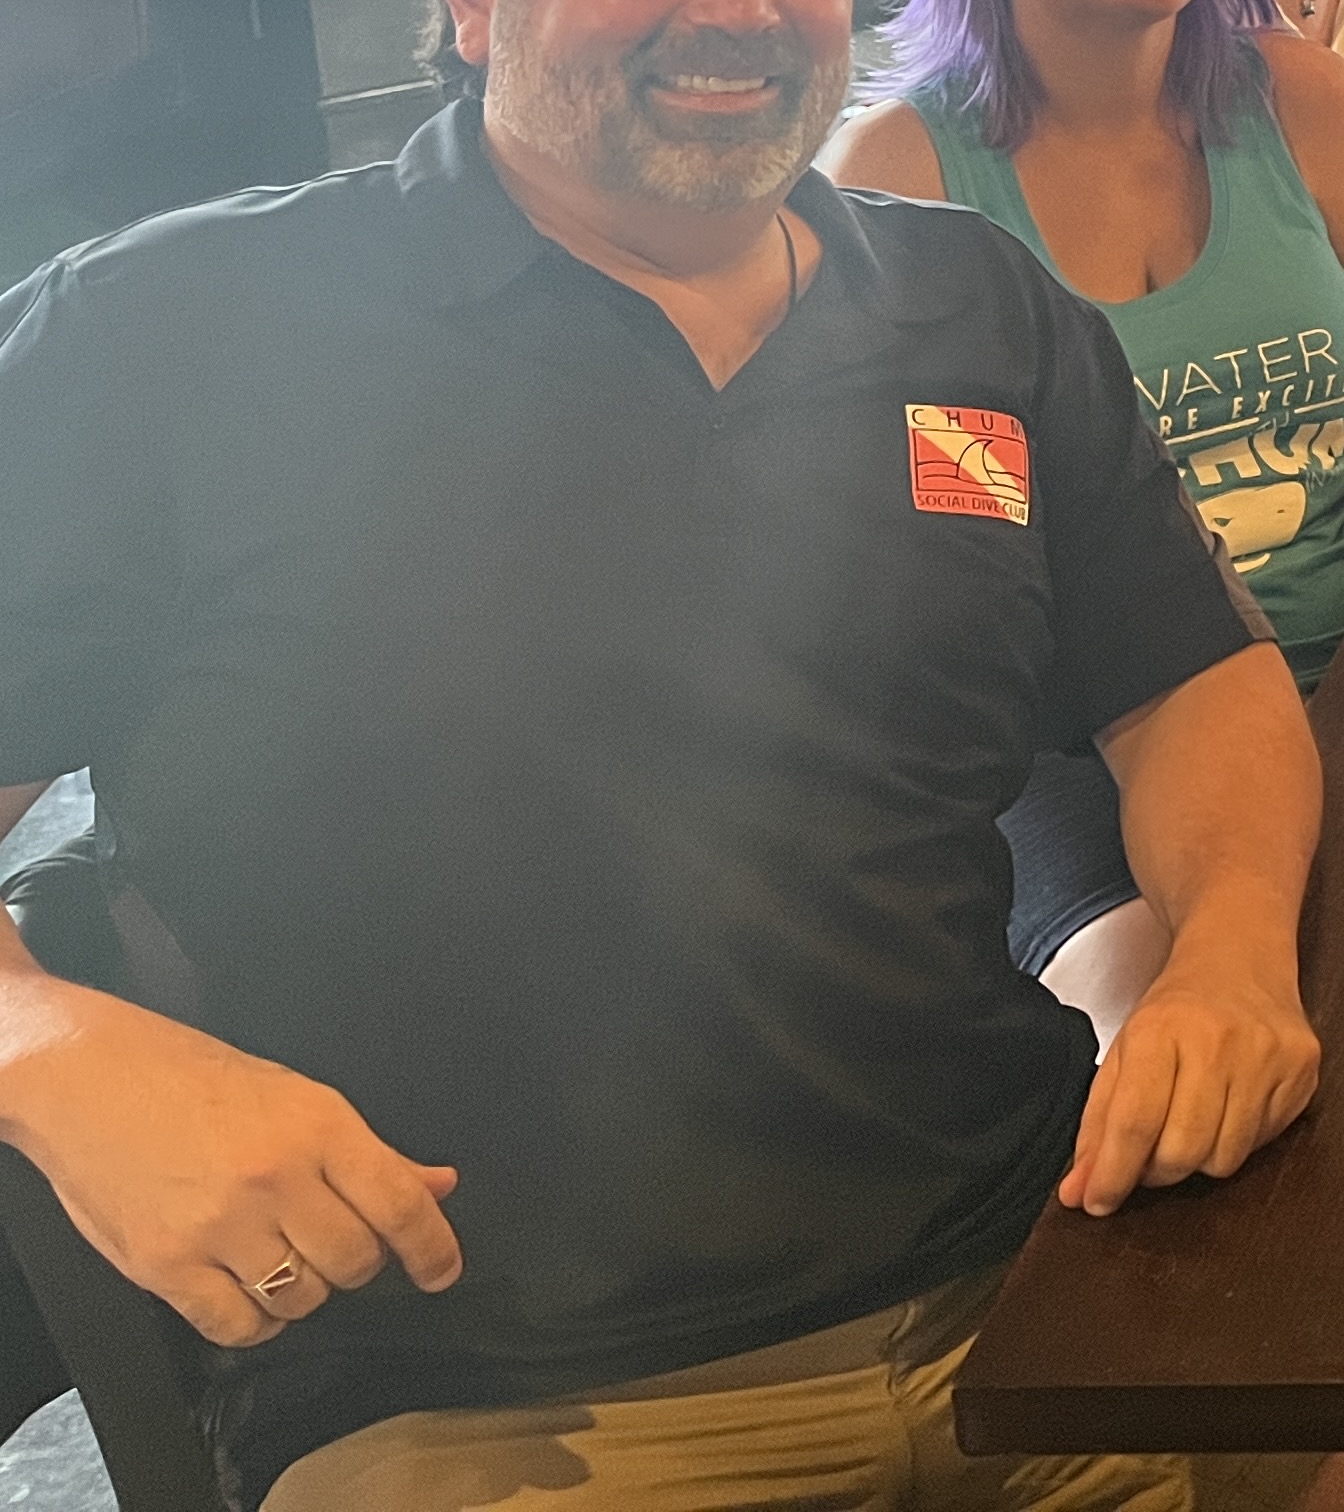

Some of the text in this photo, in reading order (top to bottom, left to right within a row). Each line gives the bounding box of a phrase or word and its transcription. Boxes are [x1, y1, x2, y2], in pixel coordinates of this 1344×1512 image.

[911, 408, 1025, 439] CHUM
[917, 494, 1026, 520] SOCIAL DIVE CLUB
